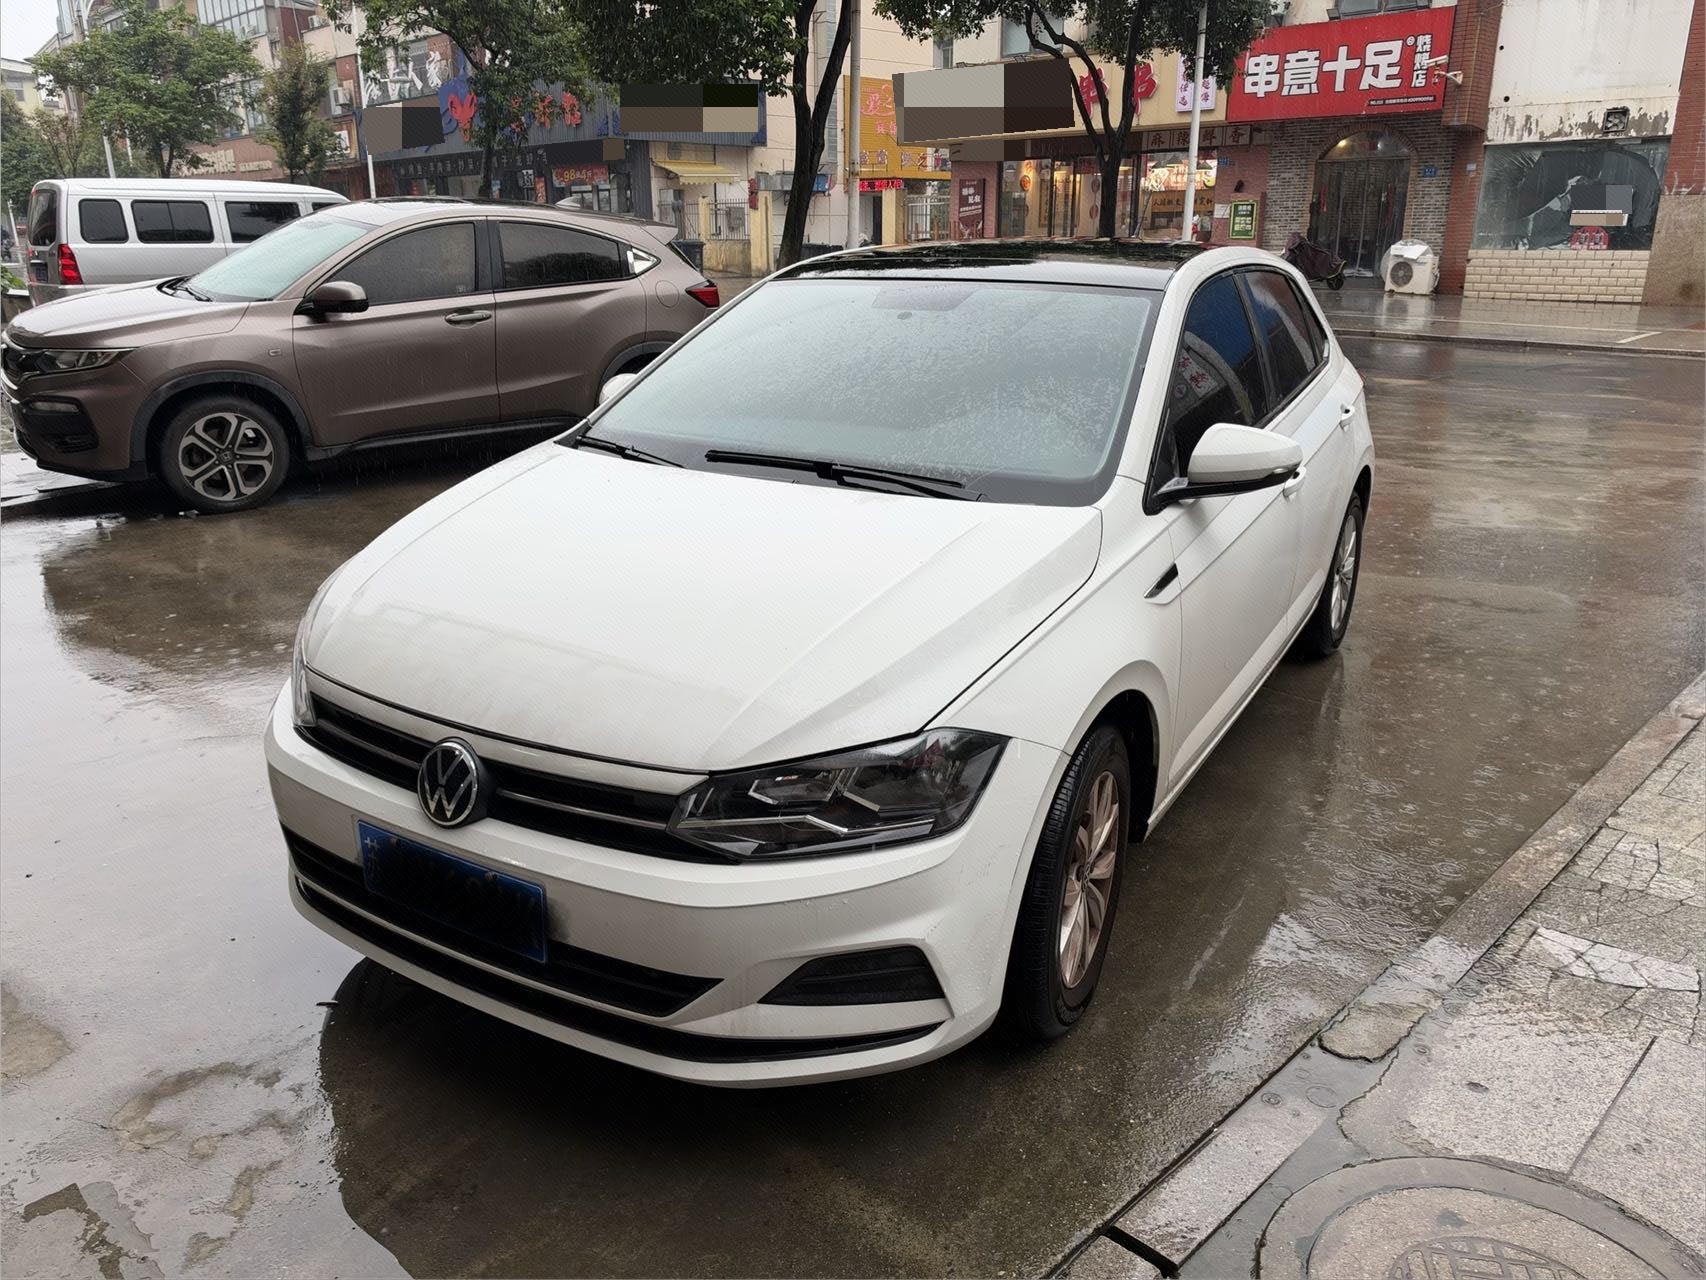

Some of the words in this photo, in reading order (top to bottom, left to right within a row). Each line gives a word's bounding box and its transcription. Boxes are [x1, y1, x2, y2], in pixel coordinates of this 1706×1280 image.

[1244, 39, 1404, 98] 串意十足
[1410, 34, 1433, 87] 烧烤店
